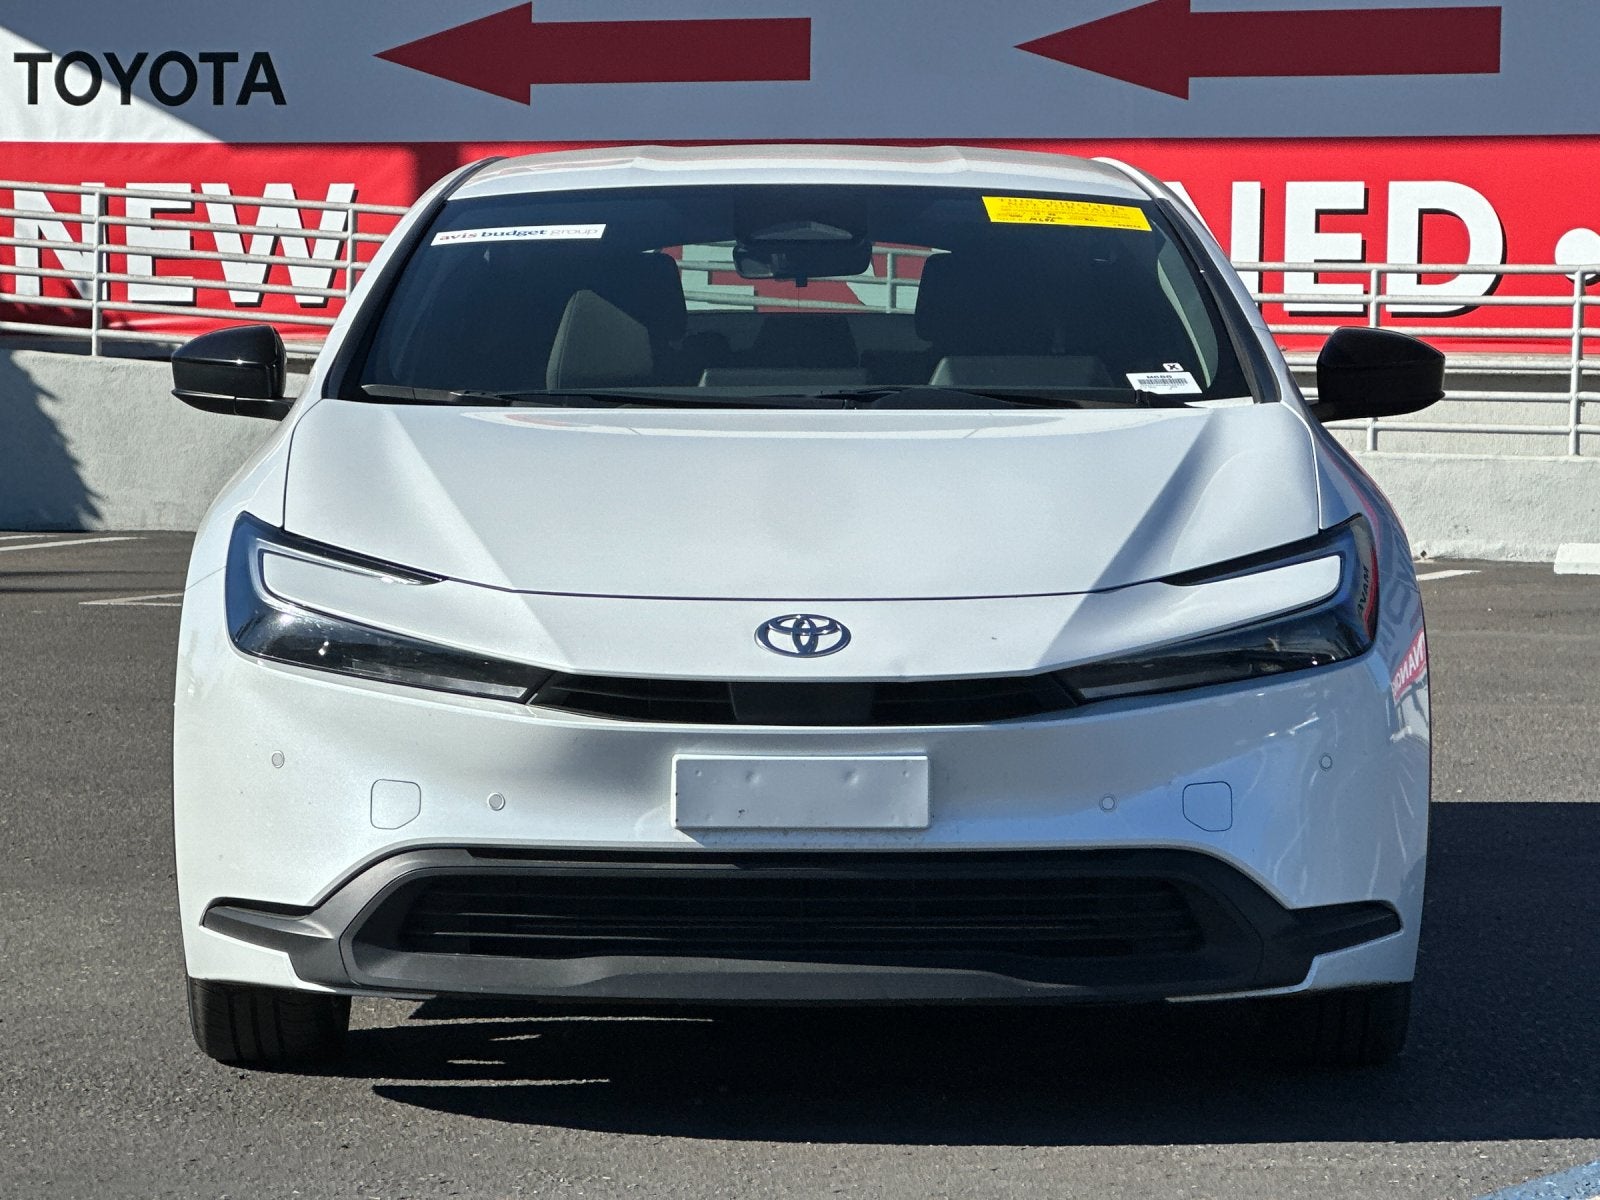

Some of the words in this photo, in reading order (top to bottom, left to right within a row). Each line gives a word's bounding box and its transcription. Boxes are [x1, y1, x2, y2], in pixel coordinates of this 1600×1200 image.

[13, 50, 287, 106] TOYOTA
[12, 181, 356, 304] NEW
[439, 231, 478, 241] avis
[481, 228, 547, 238] budget
[550, 228, 599, 237] group
